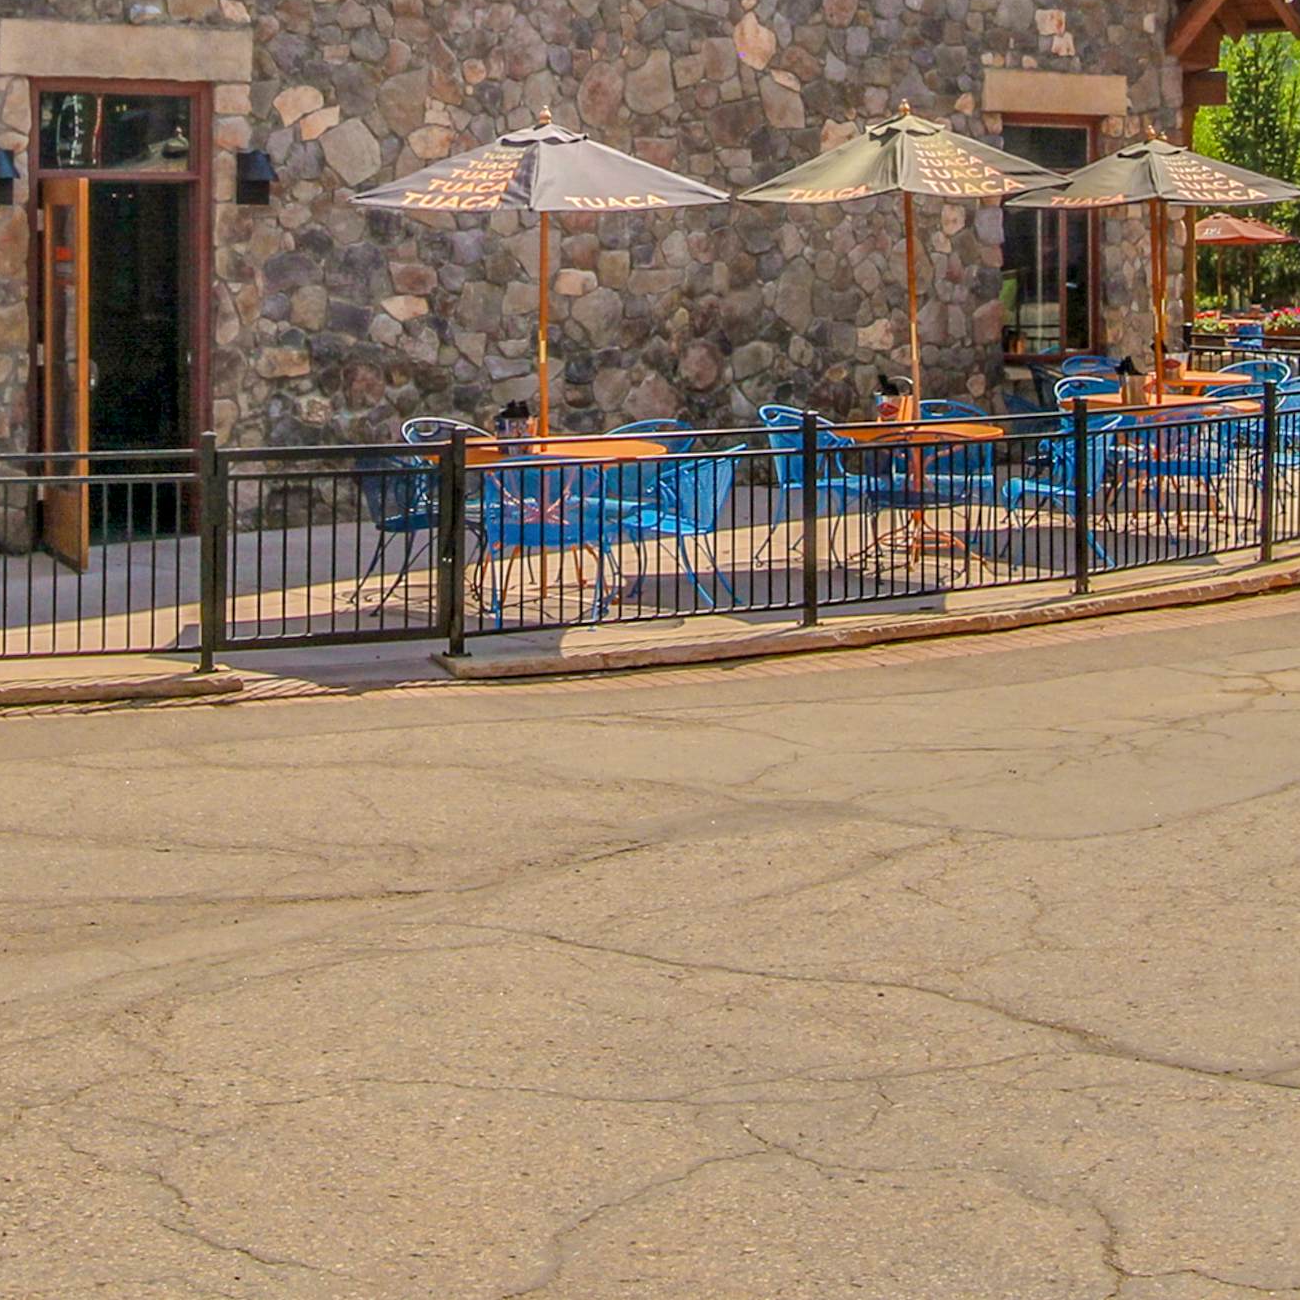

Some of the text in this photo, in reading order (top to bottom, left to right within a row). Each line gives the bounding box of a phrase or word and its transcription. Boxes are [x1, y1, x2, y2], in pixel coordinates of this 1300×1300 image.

[468, 160, 519, 169] TUACA
[917, 156, 983, 167] TUACA
[451, 168, 515, 180] TUACA
[919, 166, 1001, 179] TUACA
[1169, 172, 1227, 180] TUACA
[428, 178, 508, 193] TUACA
[922, 178, 1025, 194] TUACA
[1172, 179, 1245, 190] TUACA
[789, 185, 869, 200] TUACA
[1177, 188, 1268, 200] TUACA
[402, 191, 502, 210] TUACA
[564, 194, 668, 208] TUACA
[1052, 194, 1124, 206] TUACA
